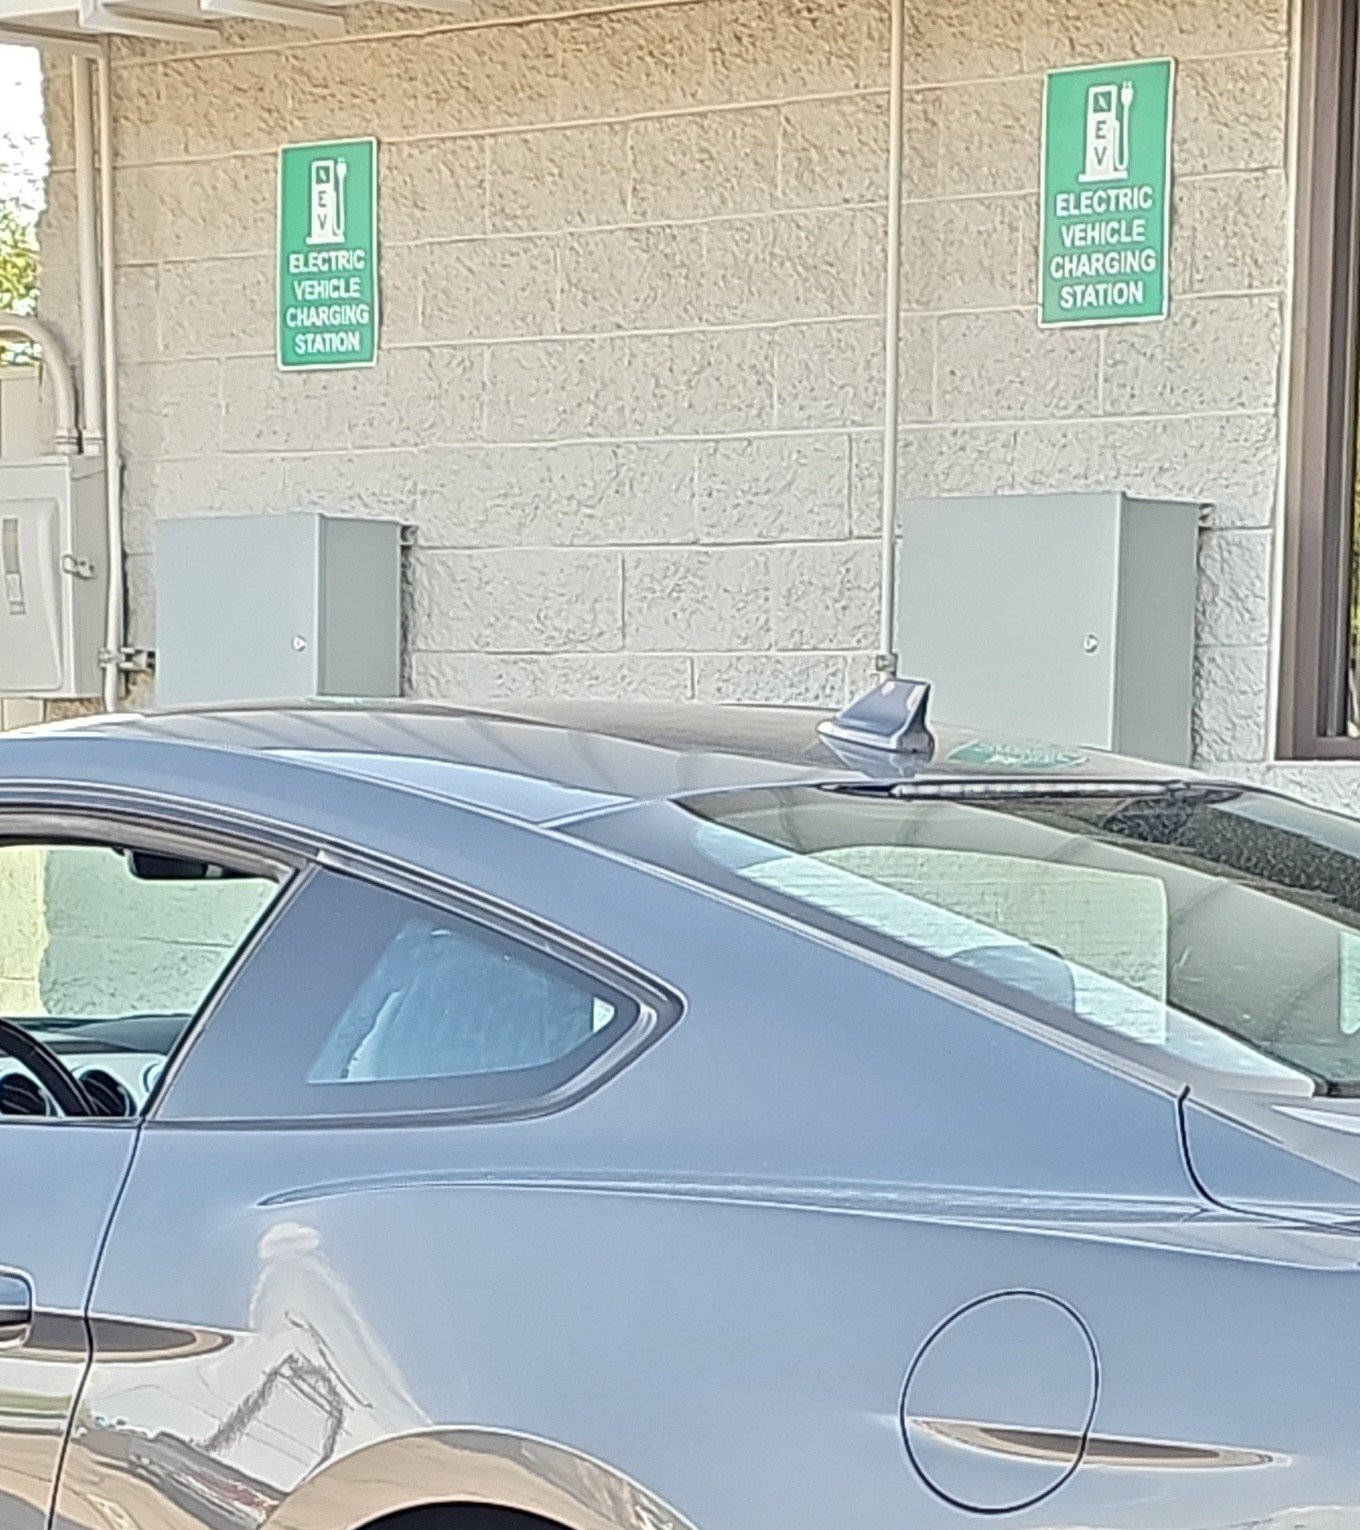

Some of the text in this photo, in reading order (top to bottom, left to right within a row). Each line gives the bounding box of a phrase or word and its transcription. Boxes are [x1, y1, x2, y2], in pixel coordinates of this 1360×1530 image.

[1055, 186, 1153, 218] ELECTRIC
[1060, 219, 1146, 248] VEHICLE
[289, 250, 365, 274] ELECTRIC
[1050, 248, 1156, 280] CHARGING
[293, 277, 361, 301] VEHICLE
[1059, 281, 1144, 310] STATION
[286, 303, 369, 328] CHARGING
[294, 331, 360, 355] STATION
